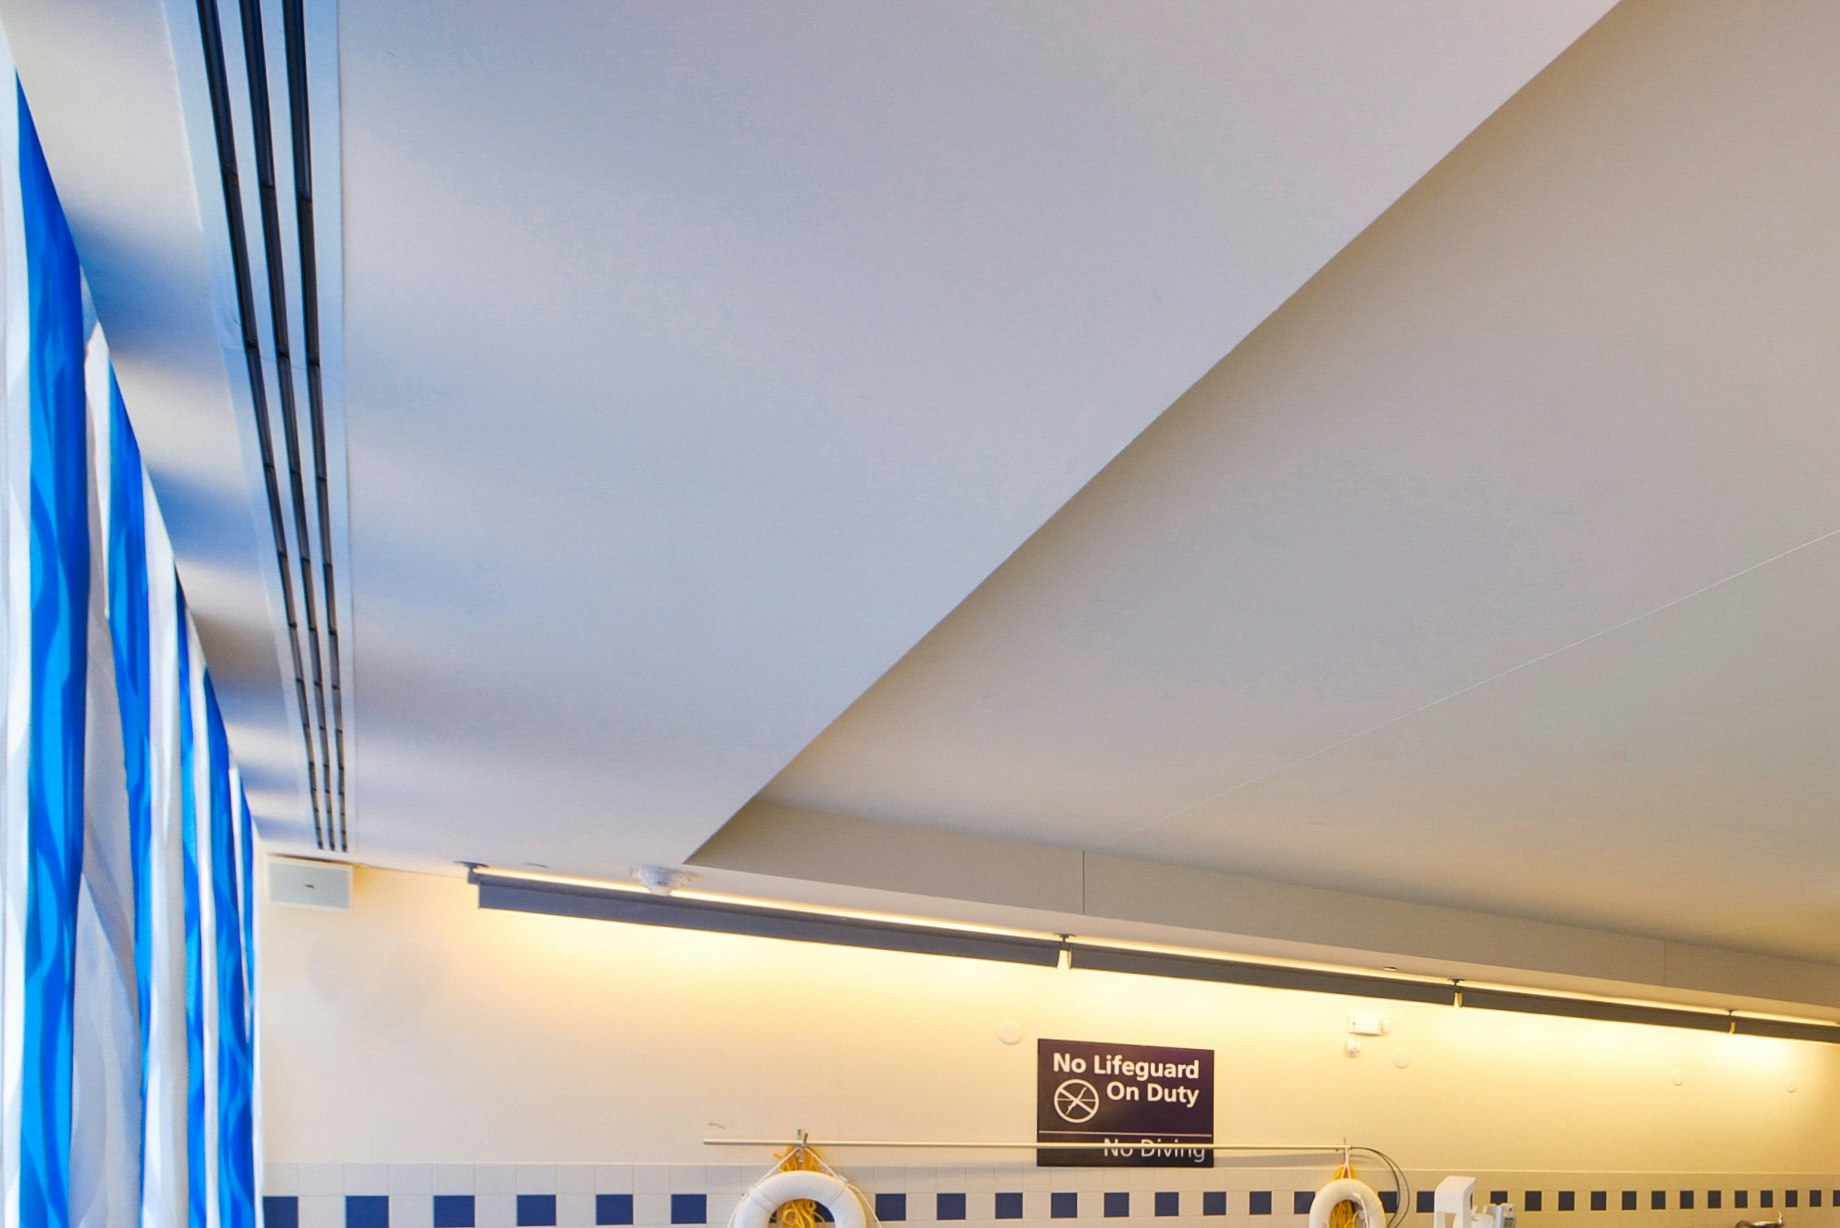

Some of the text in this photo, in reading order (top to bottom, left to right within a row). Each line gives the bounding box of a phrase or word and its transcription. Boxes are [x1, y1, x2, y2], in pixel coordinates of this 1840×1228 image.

[1053, 1052, 1200, 1081] No Lifeguard
[1106, 1081, 1200, 1108] On Duty
[1103, 1137, 1206, 1163] No Diving
